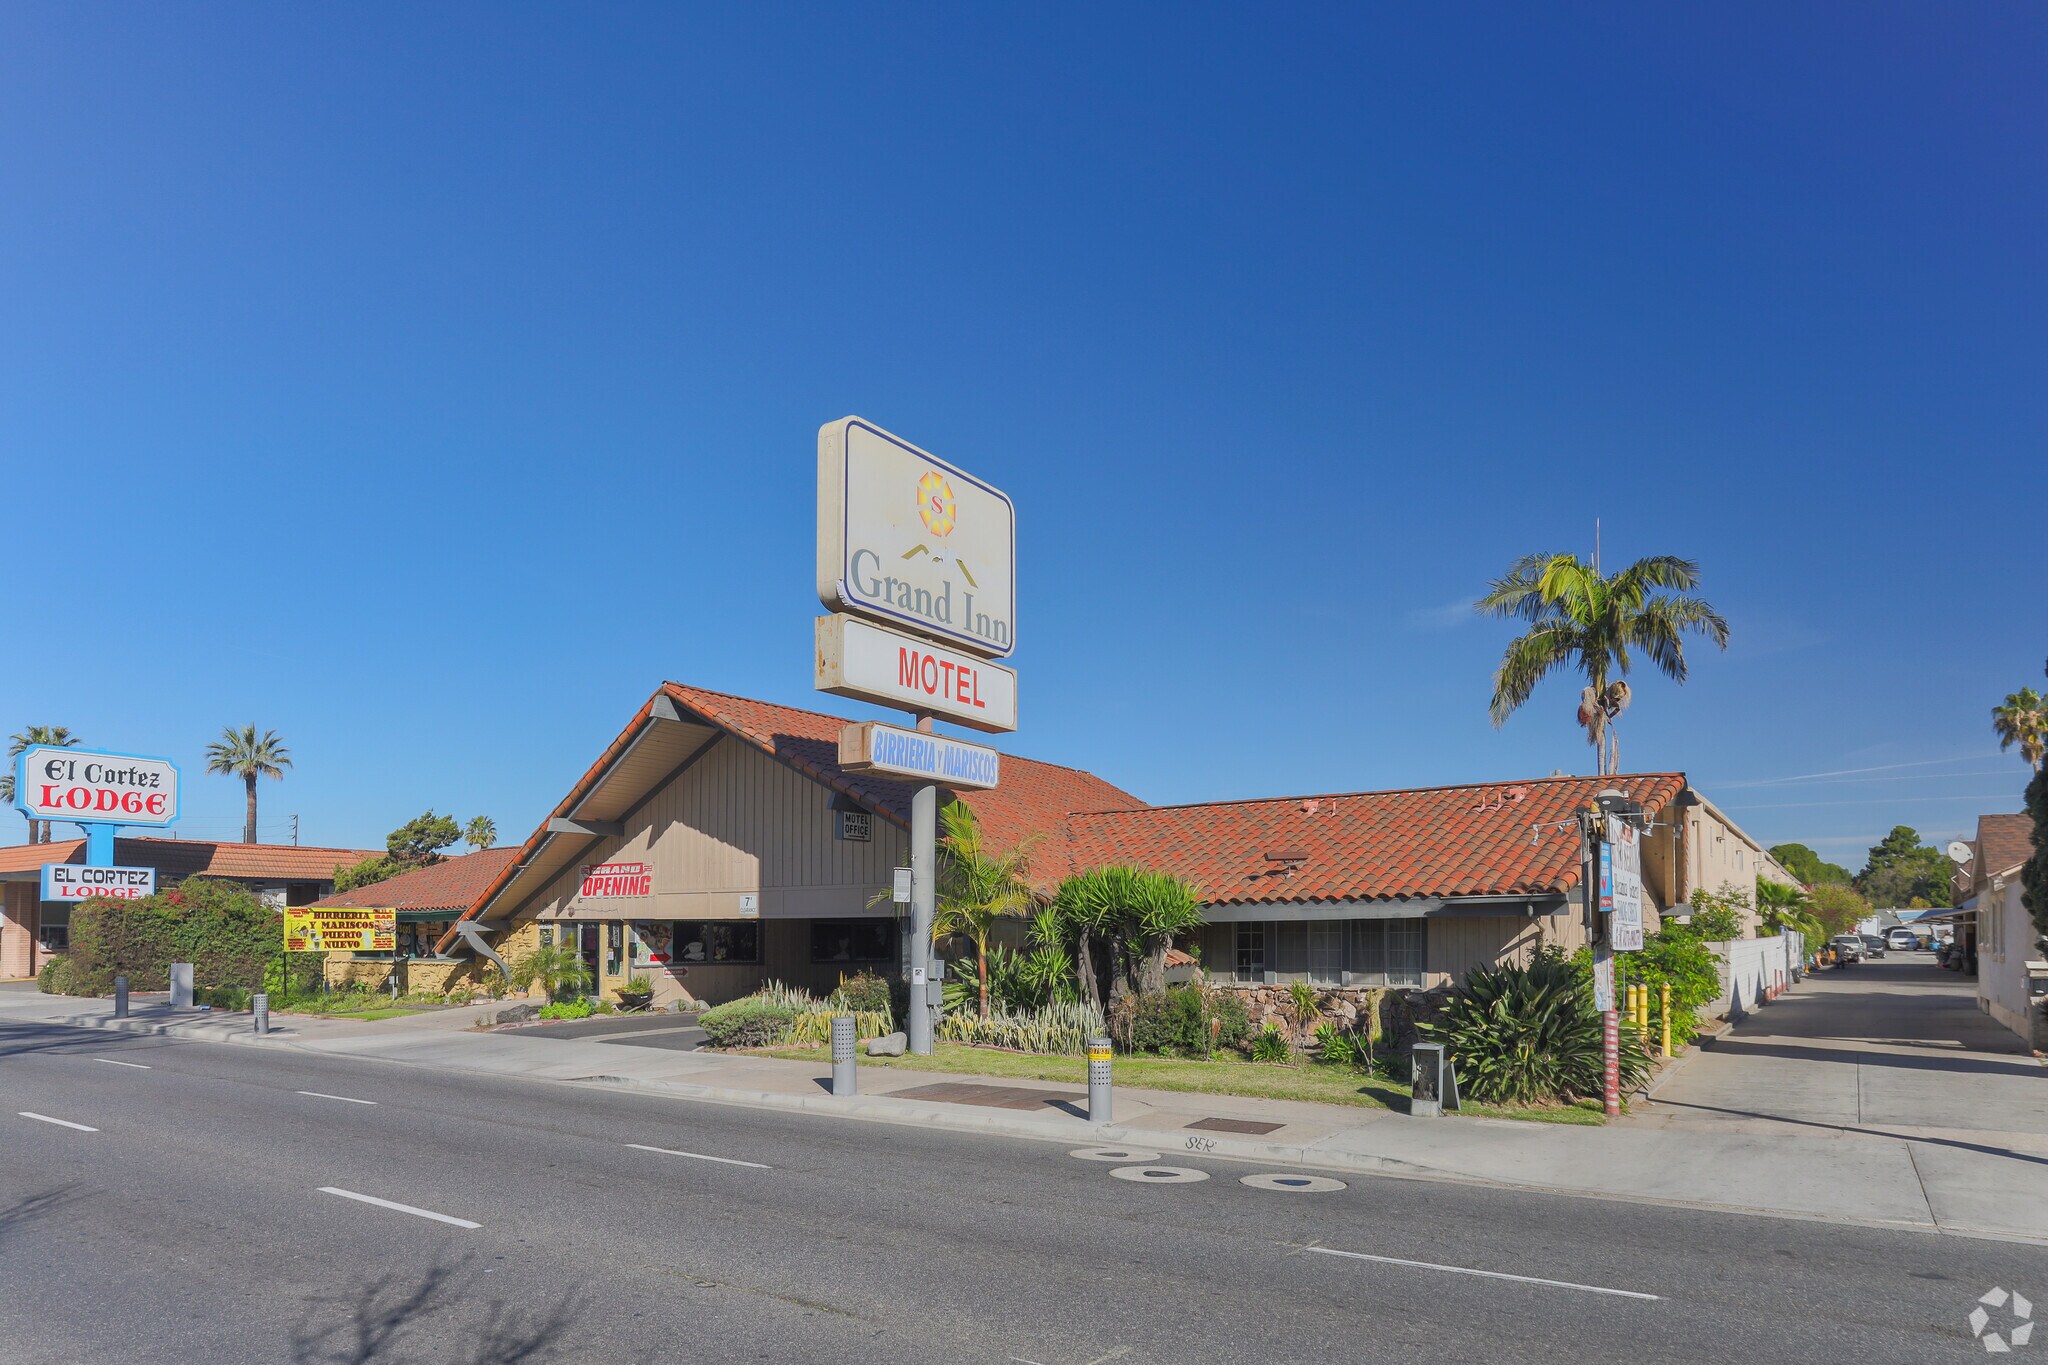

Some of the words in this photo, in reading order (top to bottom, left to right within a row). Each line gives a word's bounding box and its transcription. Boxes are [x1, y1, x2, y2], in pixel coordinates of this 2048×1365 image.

[932, 496, 943, 514] S
[851, 549, 952, 625] Grand
[963, 591, 1008, 645] Inn
[899, 647, 986, 708] MOTEL
[874, 731, 936, 773] BIRRIERIA
[943, 745, 997, 784] MARISCOS
[44, 759, 77, 782] El
[84, 763, 161, 788] Cortez
[39, 784, 168, 815] LODGE
[845, 813, 869, 825] MOTEL
[845, 824, 869, 836] OFFICE
[54, 867, 76, 883] EL
[81, 869, 149, 886] CORTEZ
[591, 865, 641, 874] GRAND
[61, 885, 142, 899] LODGE
[582, 875, 652, 896] OPENING
[313, 911, 370, 919] BIRRIERIA
[309, 921, 316, 929] Y
[321, 921, 374, 929] MARISCOS
[322, 931, 362, 939] PUERTO
[324, 941, 360, 949] NUEVO
